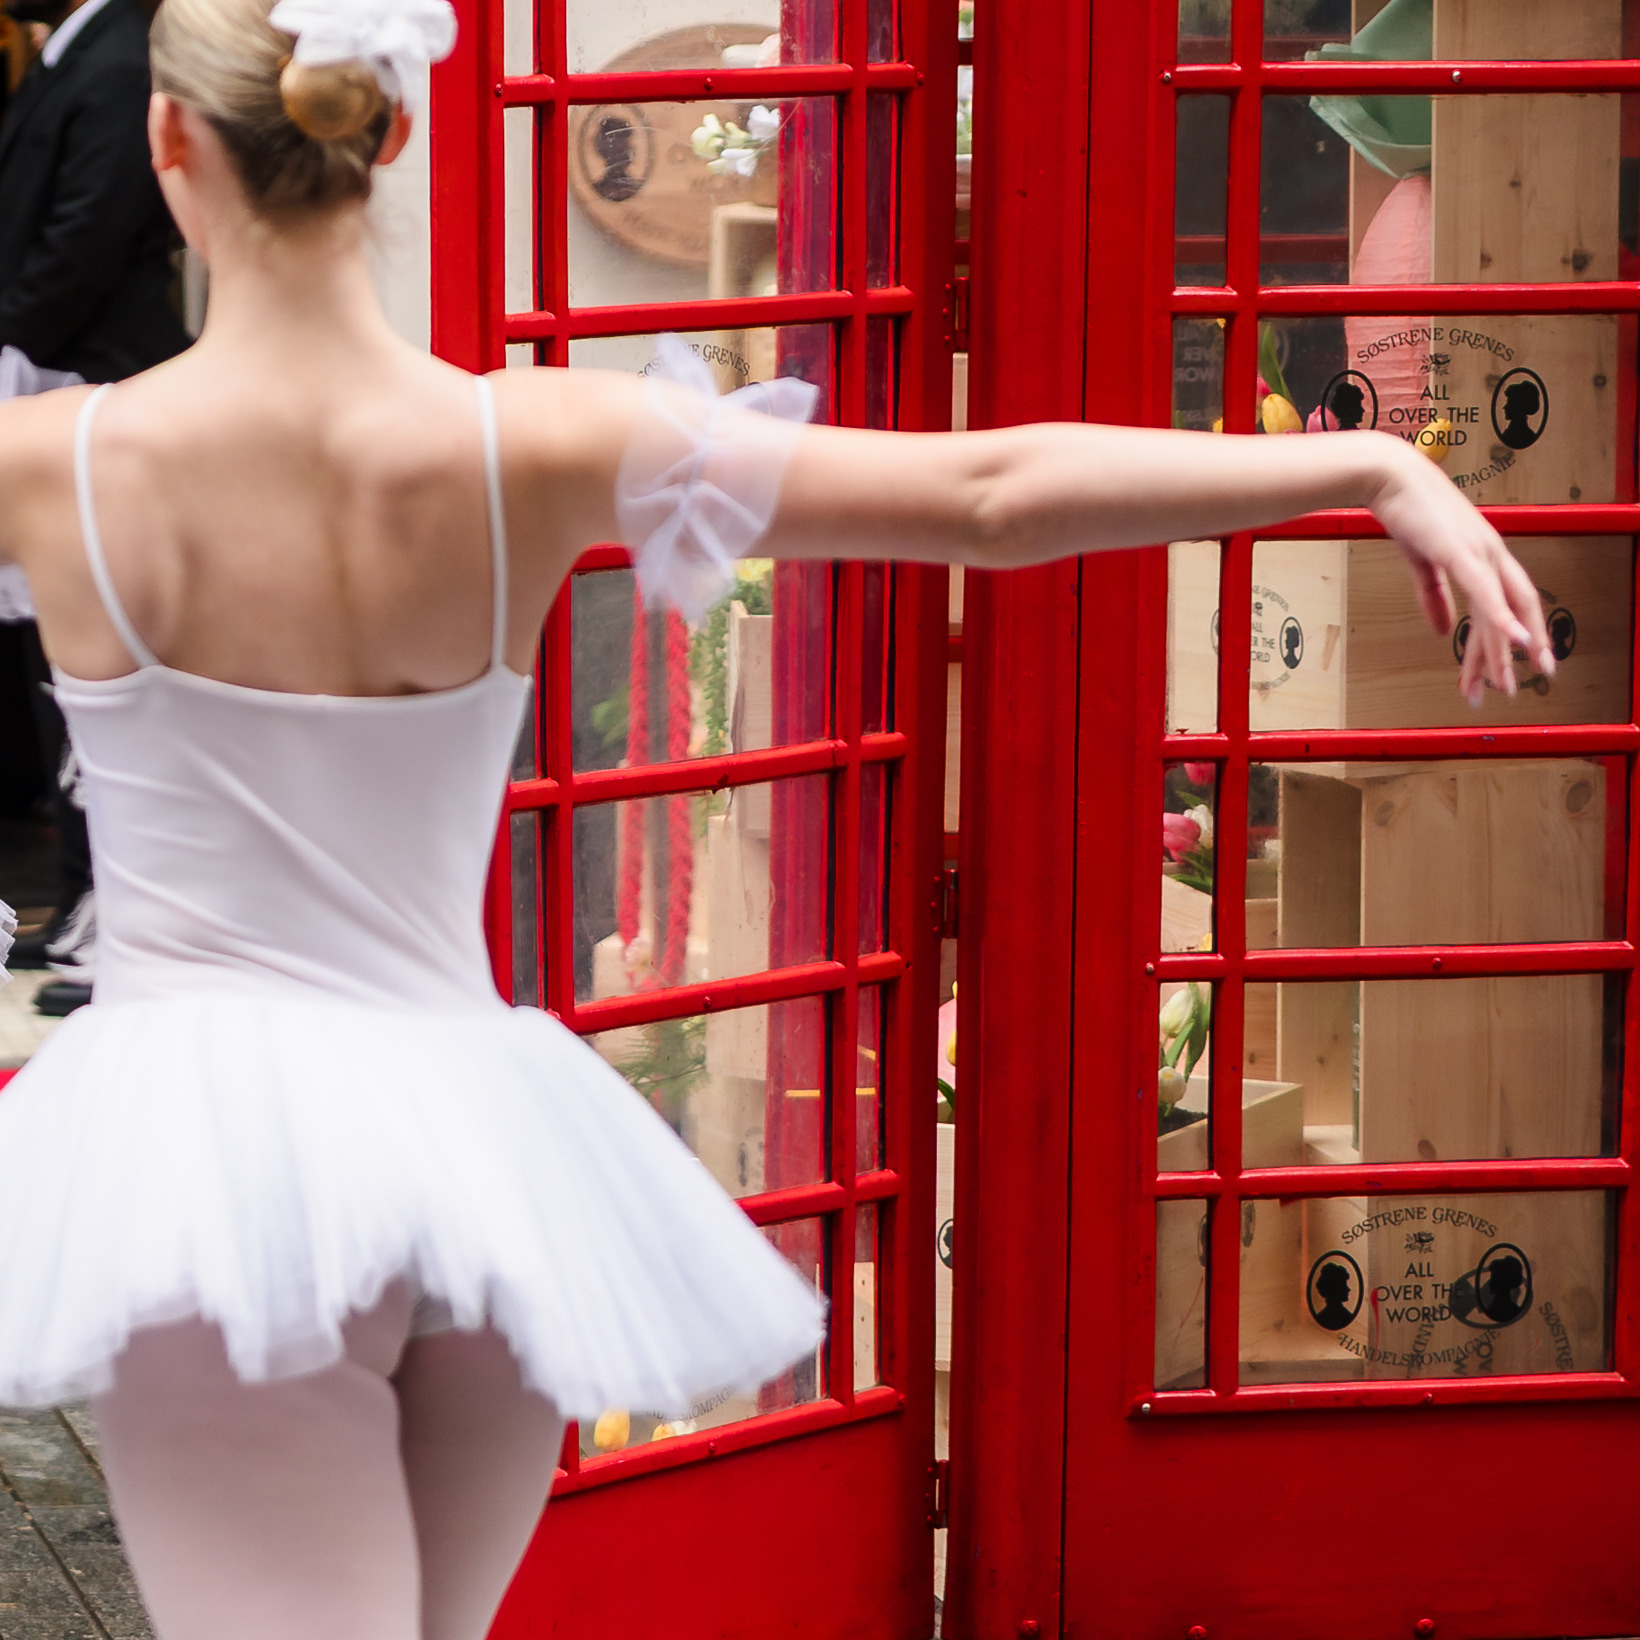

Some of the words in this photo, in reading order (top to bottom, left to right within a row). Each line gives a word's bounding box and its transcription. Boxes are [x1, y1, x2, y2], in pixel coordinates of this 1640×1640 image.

[1357, 327, 1444, 364] SØSTRENE
[1449, 328, 1514, 362] GRENES
[703, 344, 751, 376] GRENES
[1420, 385, 1449, 400] ALL
[1389, 407, 1438, 423] OVER
[1447, 407, 1479, 423] THE
[1400, 430, 1467, 446] WORLD
[1262, 637, 1275, 649] THE
[1251, 650, 1271, 662] ORLD
[1341, 1206, 1427, 1244] SØSTRENE
[1432, 1207, 1498, 1238] GRENES
[1405, 1262, 1434, 1278] ALL
[1375, 1284, 1423, 1302] OVER
[1431, 1283, 1464, 1300] THE
[1385, 1306, 1453, 1323] WORLD
